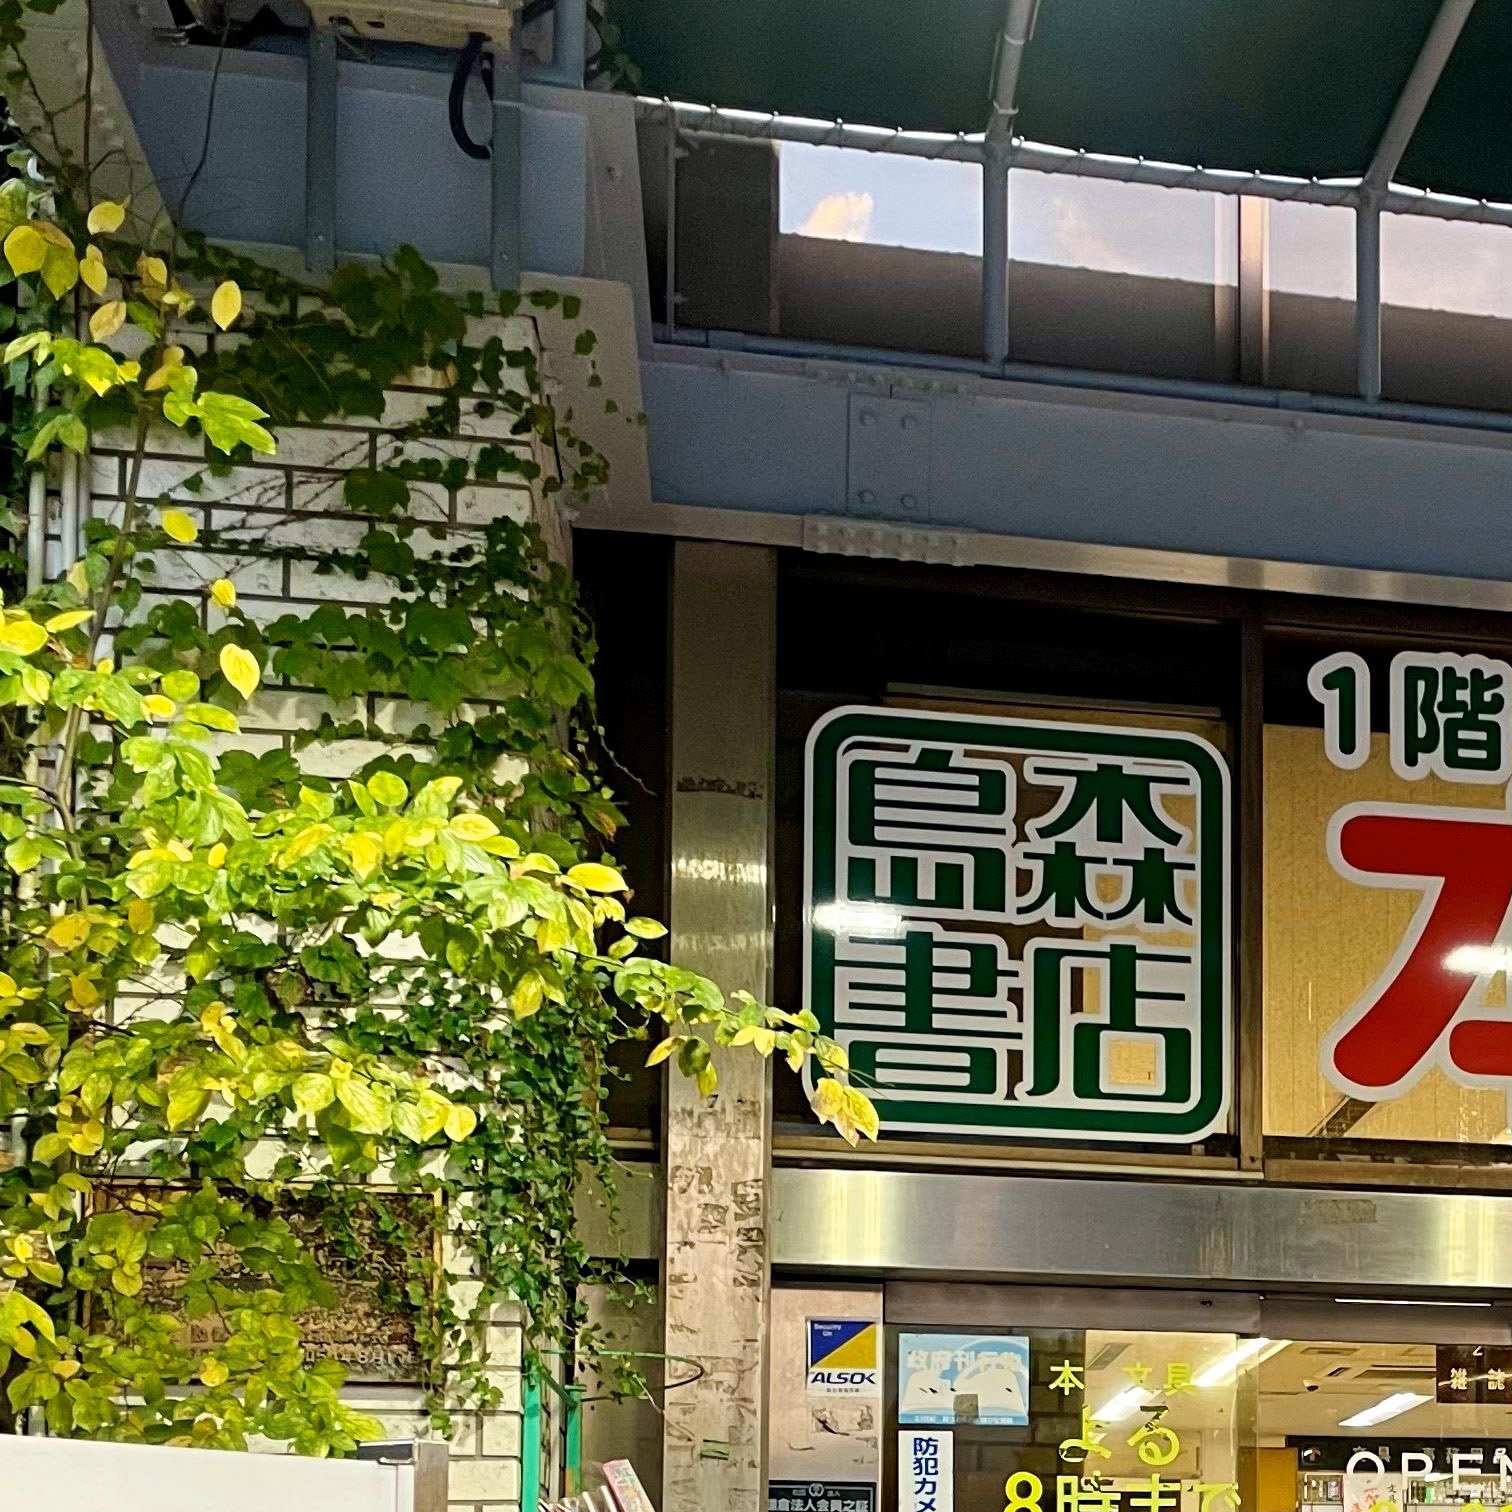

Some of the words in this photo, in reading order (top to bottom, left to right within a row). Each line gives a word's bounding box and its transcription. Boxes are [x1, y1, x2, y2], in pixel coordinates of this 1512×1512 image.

[1316, 660, 1511, 776] 1階
[831, 928, 1196, 1102] 書店
[810, 1371, 877, 1385] ALSOK
[1048, 1359, 1085, 1396] 本
